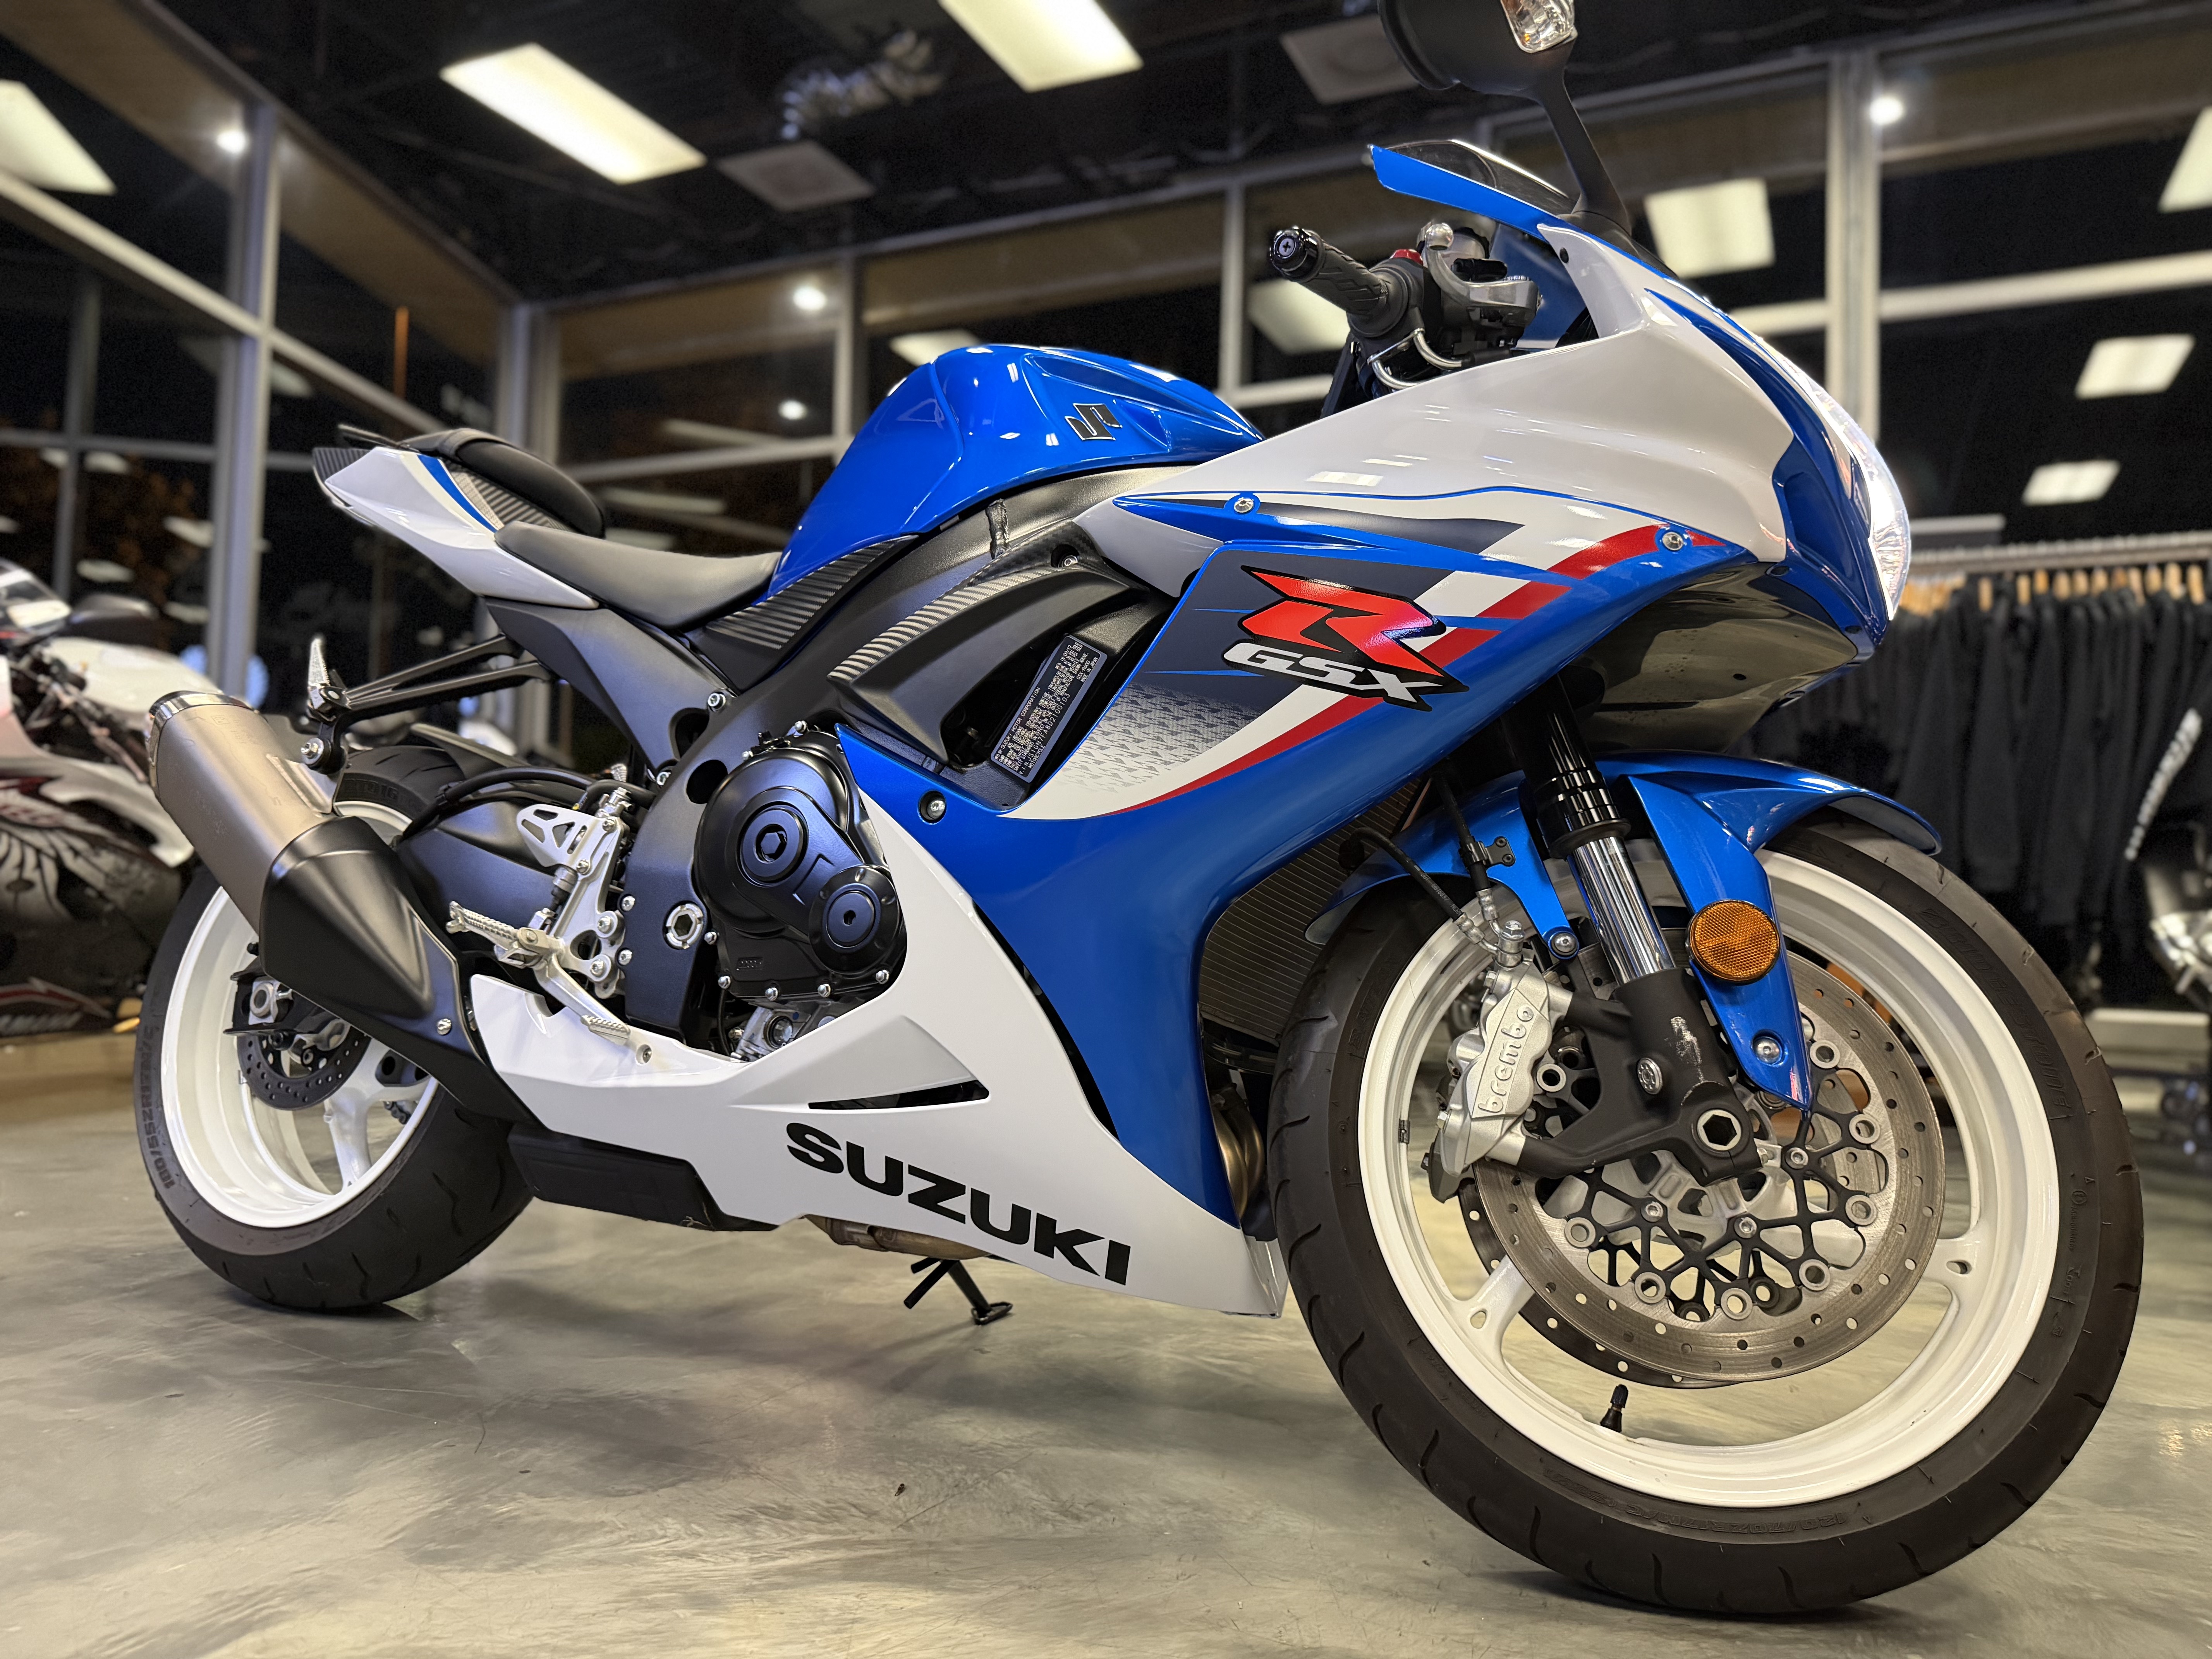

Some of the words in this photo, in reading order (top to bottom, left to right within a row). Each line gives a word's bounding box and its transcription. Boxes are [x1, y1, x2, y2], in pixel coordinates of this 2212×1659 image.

[1011, 717, 1022, 732] MOTOR
[1020, 687, 1041, 717] CORPORATION
[1015, 746, 1026, 761] VEHICLE
[1061, 672, 1071, 683] MOTOR
[1068, 658, 1080, 672] VEHICLE
[1075, 659, 1091, 680] GSX-R600
[1080, 673, 1088, 683] MADE
[1089, 656, 1098, 668] JAPAN
[1223, 641, 1444, 703] GSX
[1013, 759, 1024, 772] SAFETY
[1021, 740, 1034, 759] STANDARDS
[1050, 701, 1058, 711] DATE
[1059, 674, 1075, 696] MANUFACTURE
[1072, 663, 1082, 674] SHOWN
[1028, 744, 1045, 769] MOTORCYCLE
[1917, 905, 2071, 1107] BRIDGESTONE
[1477, 1006, 1534, 1113] brembo
[786, 1122, 1131, 1285] SUZUKI
